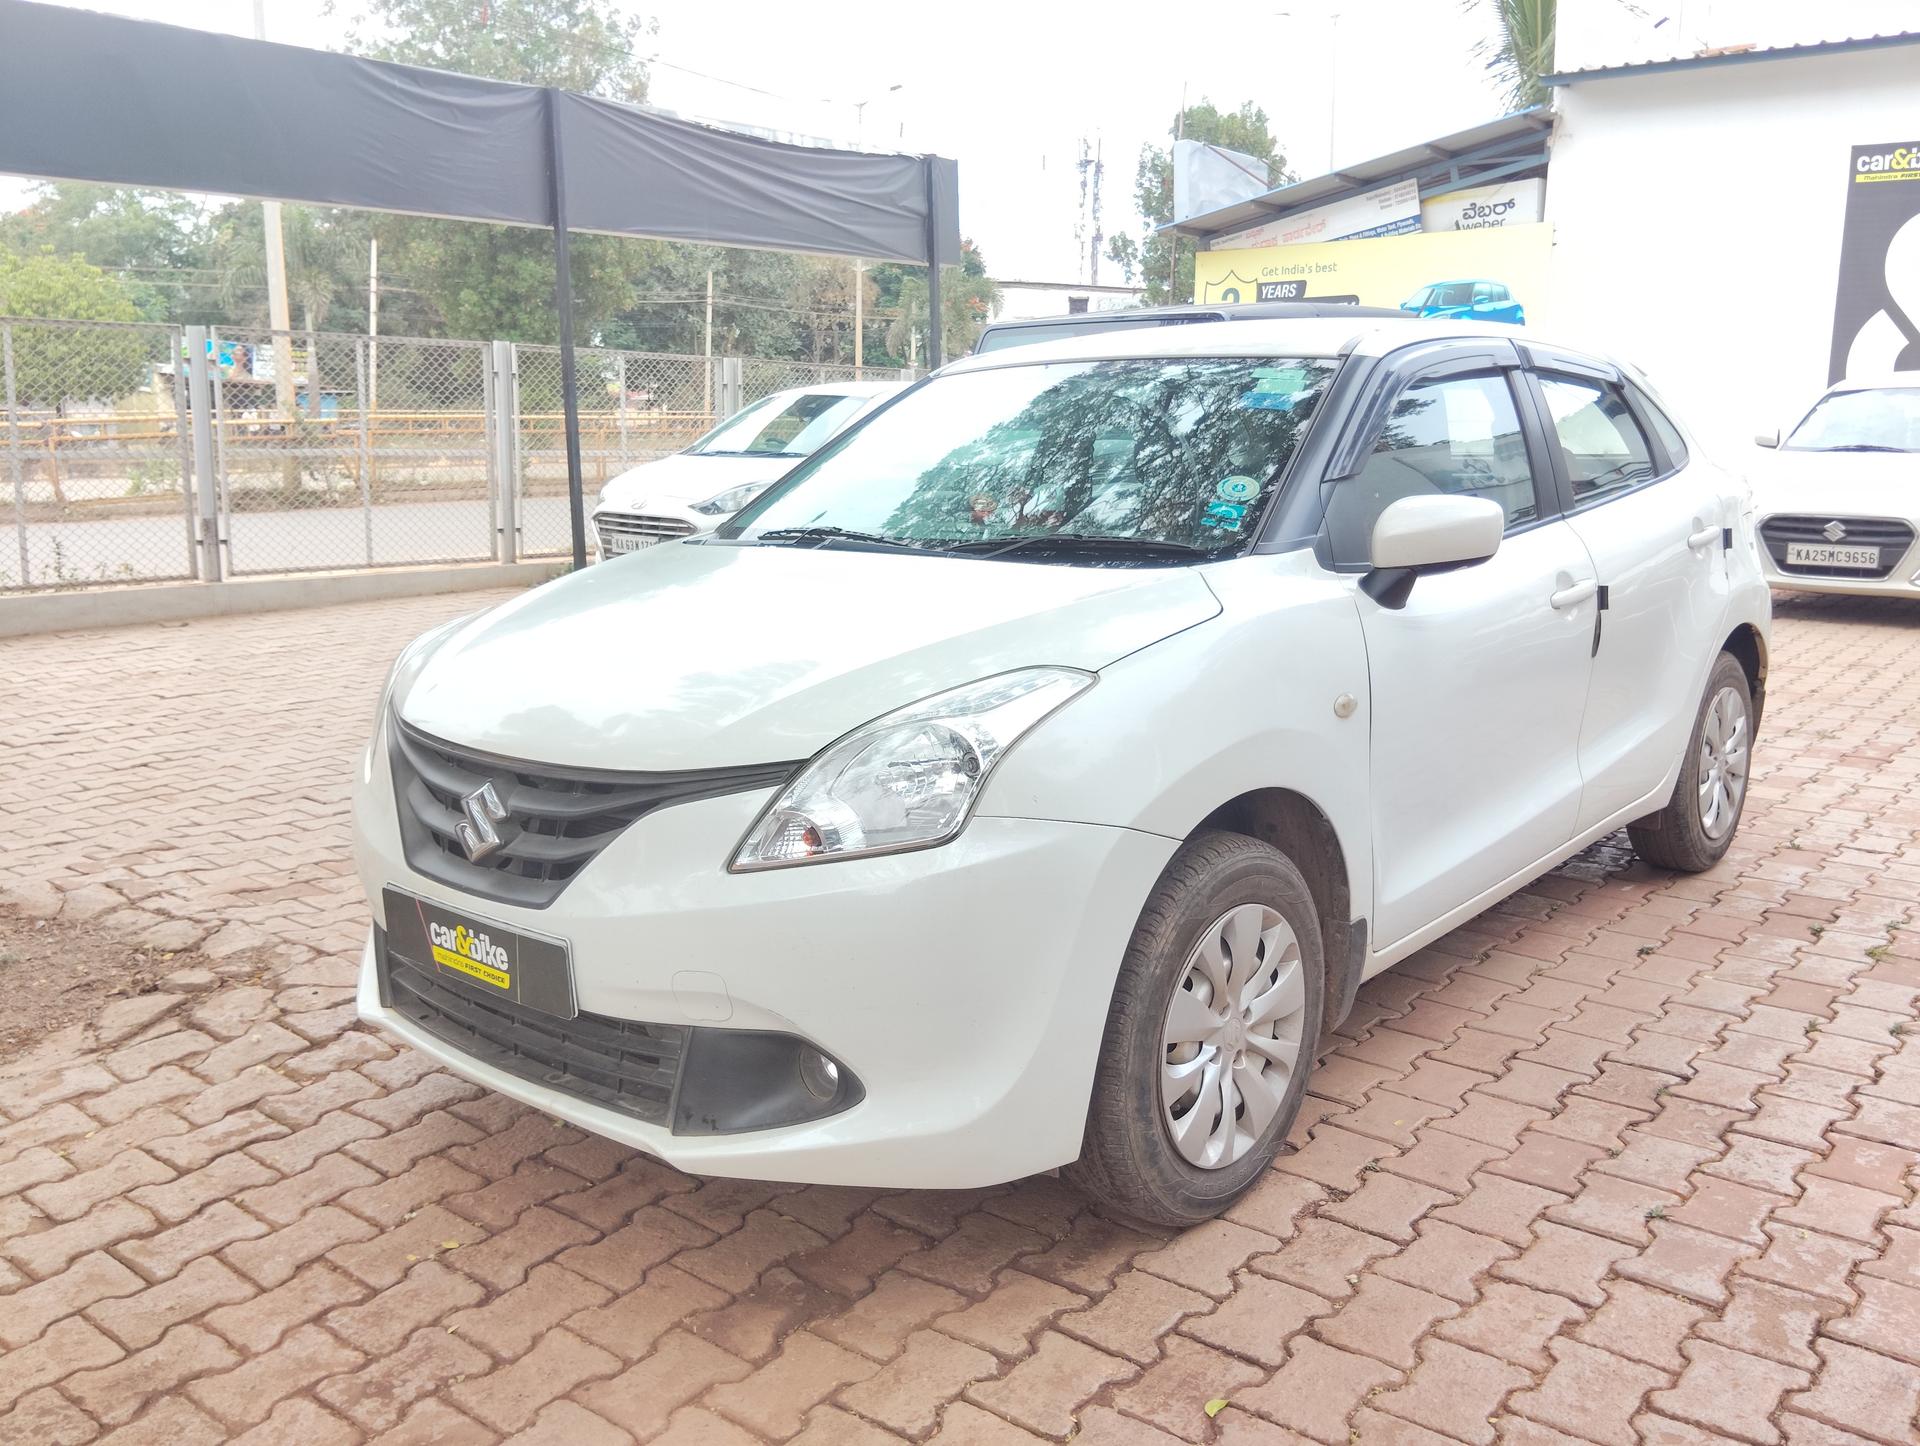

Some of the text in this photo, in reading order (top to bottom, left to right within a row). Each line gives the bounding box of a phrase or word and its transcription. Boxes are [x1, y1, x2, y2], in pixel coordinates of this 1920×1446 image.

[1462, 218, 1506, 231] weber
[1261, 262, 1338, 277] Get India's best
[1261, 283, 1297, 299] YEARS
[1796, 549, 1876, 564] KA25MC9656
[464, 963, 481, 974] FIRST
[483, 970, 505, 984] CHOICE
